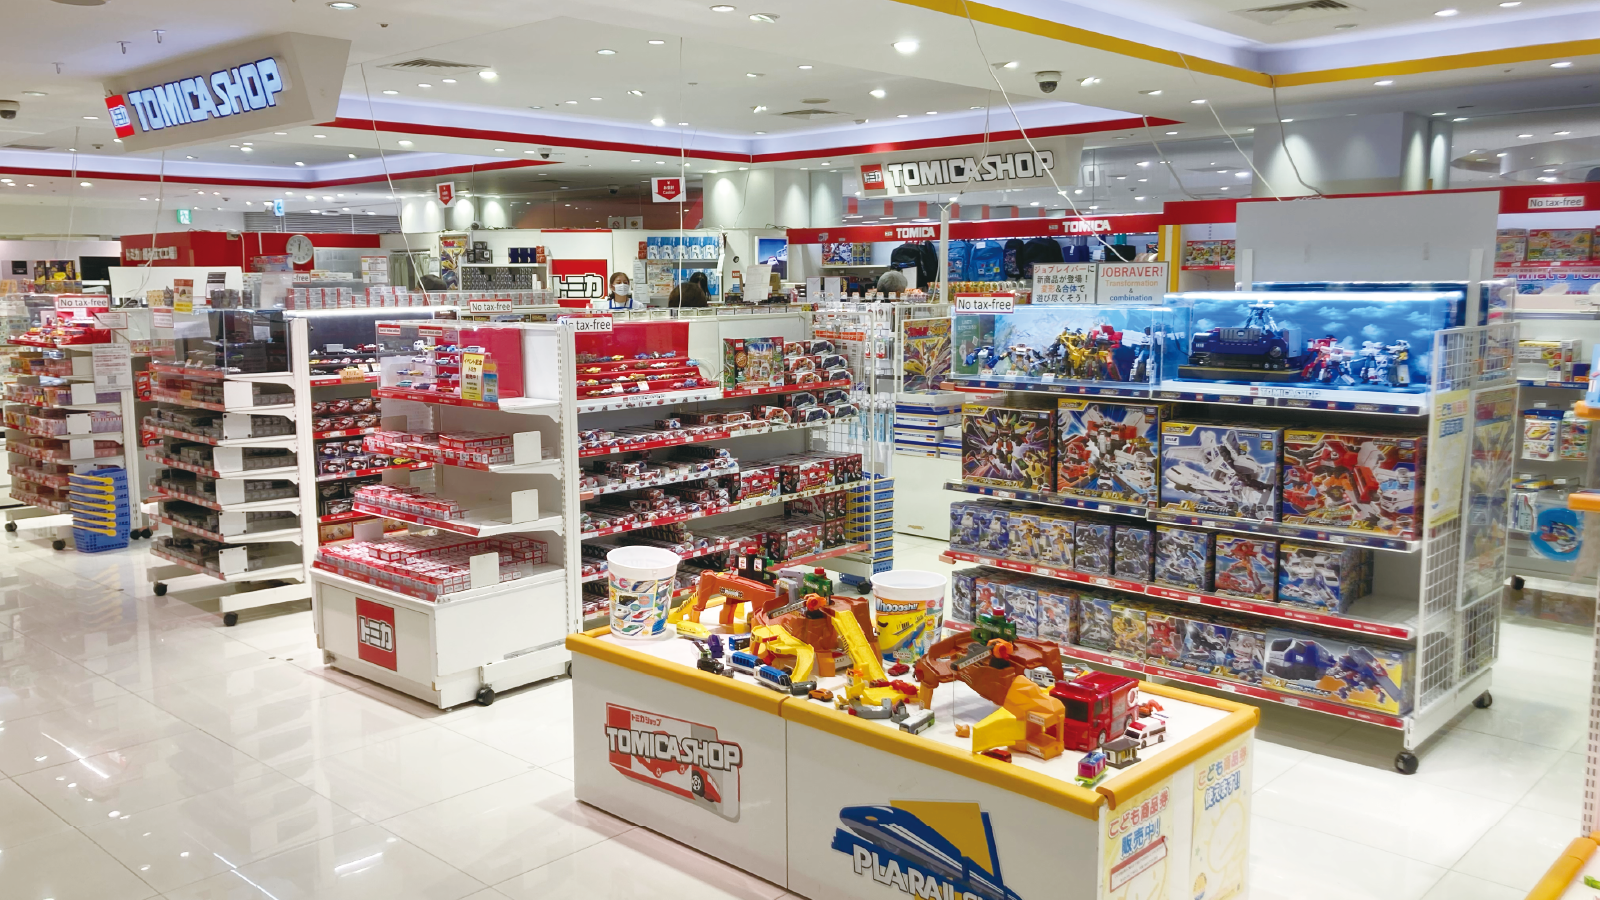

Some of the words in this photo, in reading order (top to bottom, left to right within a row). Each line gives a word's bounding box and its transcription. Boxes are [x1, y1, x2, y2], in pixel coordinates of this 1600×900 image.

[1530, 199, 1543, 207] No
[1545, 197, 1582, 206] tax-free
[896, 226, 935, 239] TOMICA
[1062, 219, 1111, 233] TOMICA
[1101, 266, 1164, 278] JOBRAVER!
[551, 273, 604, 299] トミカ
[60, 299, 72, 307] No
[75, 298, 107, 307] tax-free
[472, 303, 482, 311] No
[484, 302, 511, 311] tax-free
[958, 299, 971, 310] No
[974, 298, 1012, 311] tax-free
[576, 319, 611, 331] tax-free
[358, 615, 394, 652] トミカ
[631, 714, 662, 727] トミカショップ
[1109, 788, 1169, 838] こども商品券
